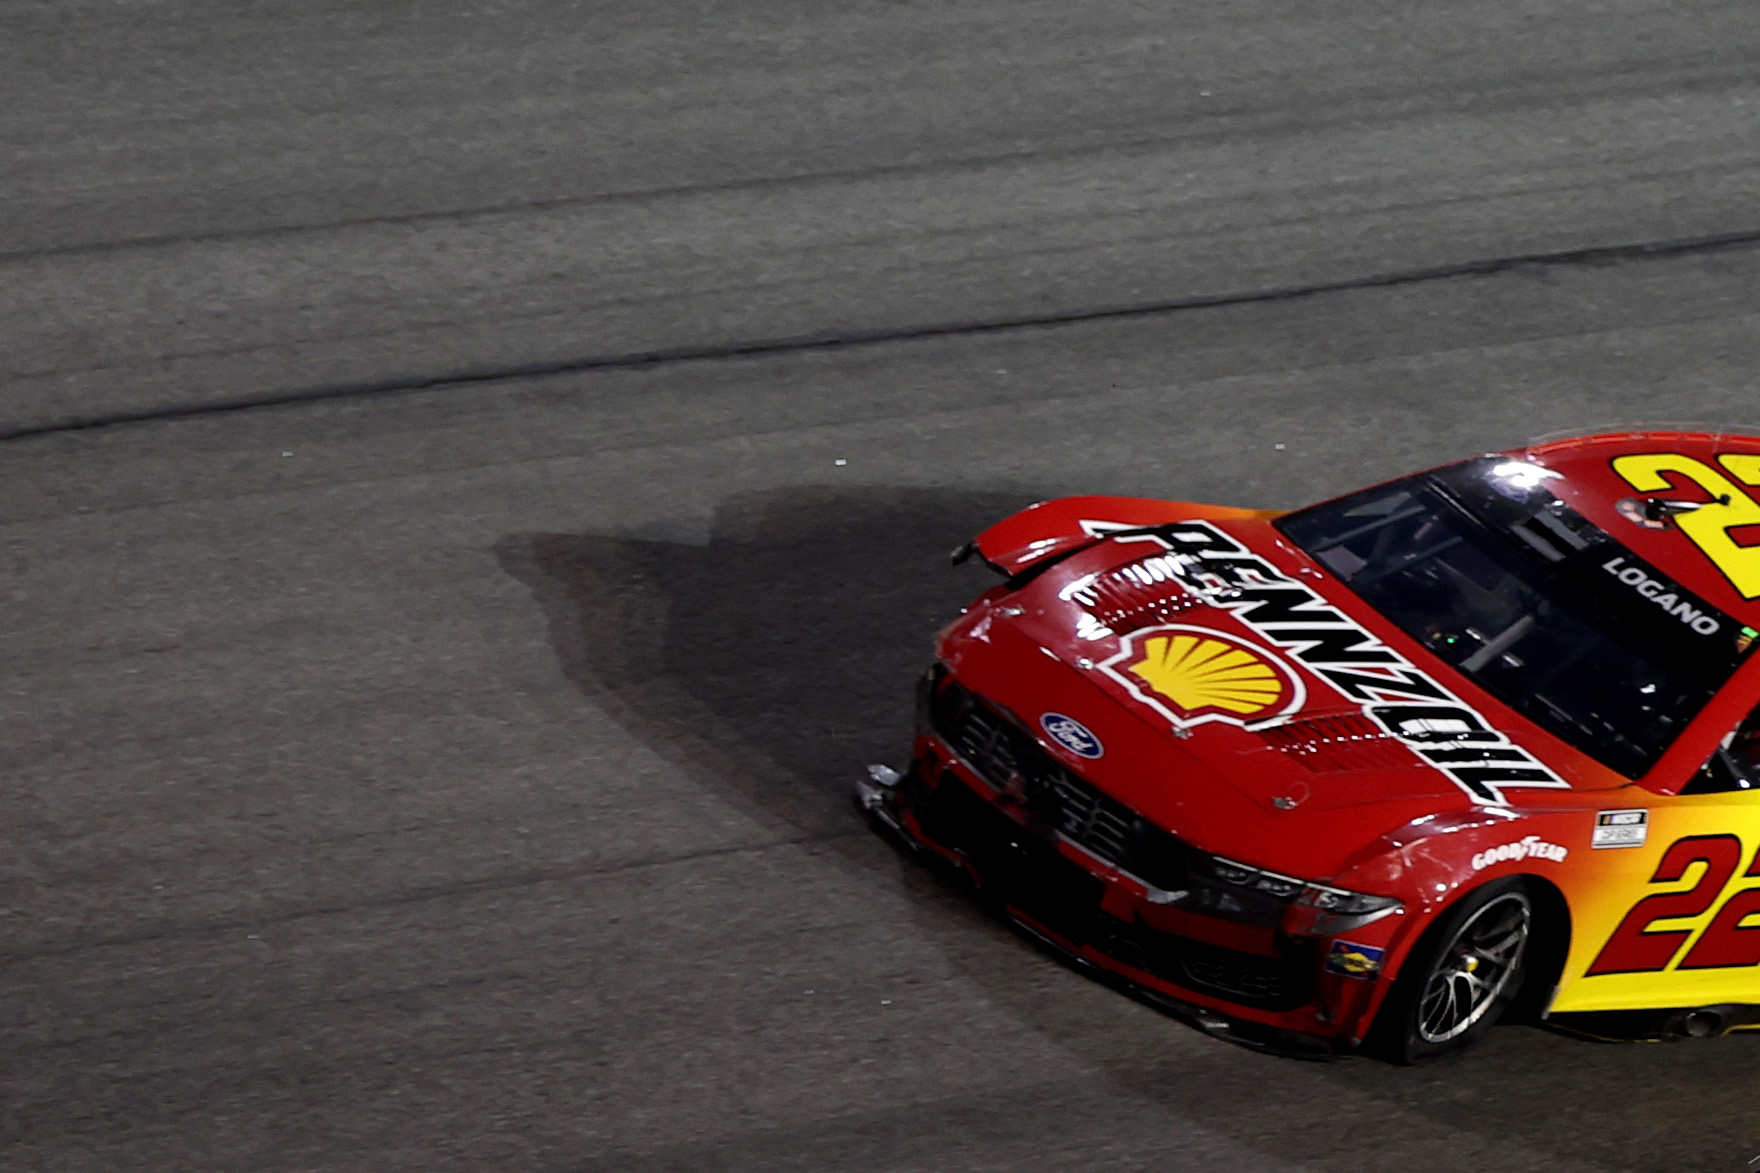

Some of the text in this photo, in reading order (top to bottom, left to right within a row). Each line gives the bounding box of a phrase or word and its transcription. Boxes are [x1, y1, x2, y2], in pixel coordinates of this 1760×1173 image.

[1601, 557, 1720, 635] LOGANO
[1045, 718, 1097, 754] Ford
[1471, 835, 1569, 871] GOODYEAR
